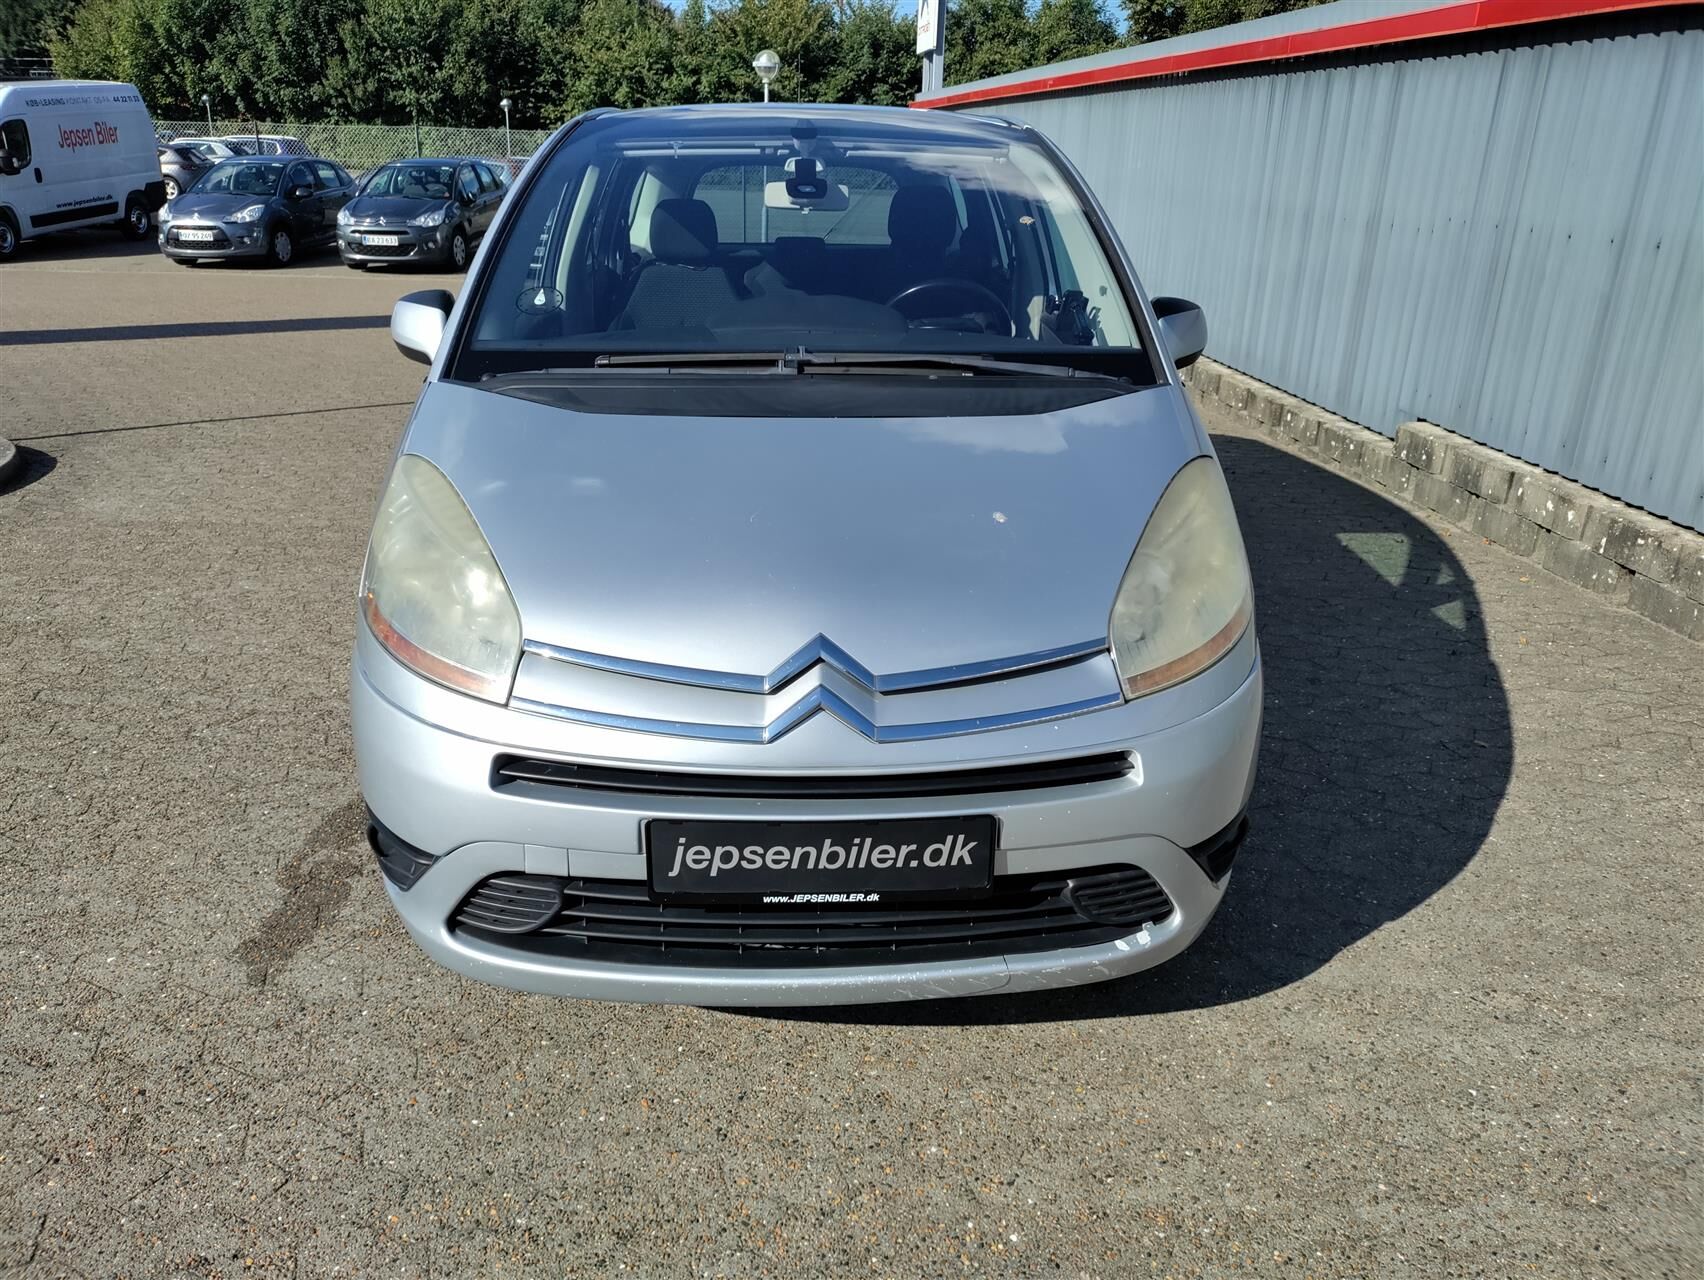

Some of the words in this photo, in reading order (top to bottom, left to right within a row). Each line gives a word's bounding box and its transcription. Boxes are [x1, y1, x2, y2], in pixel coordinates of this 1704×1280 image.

[57, 124, 95, 153] Jepsen
[94, 121, 119, 145] Biler
[668, 834, 979, 877] jepsenbiler.dk
[763, 892, 880, 904] www.JEPSENBILER.dk
